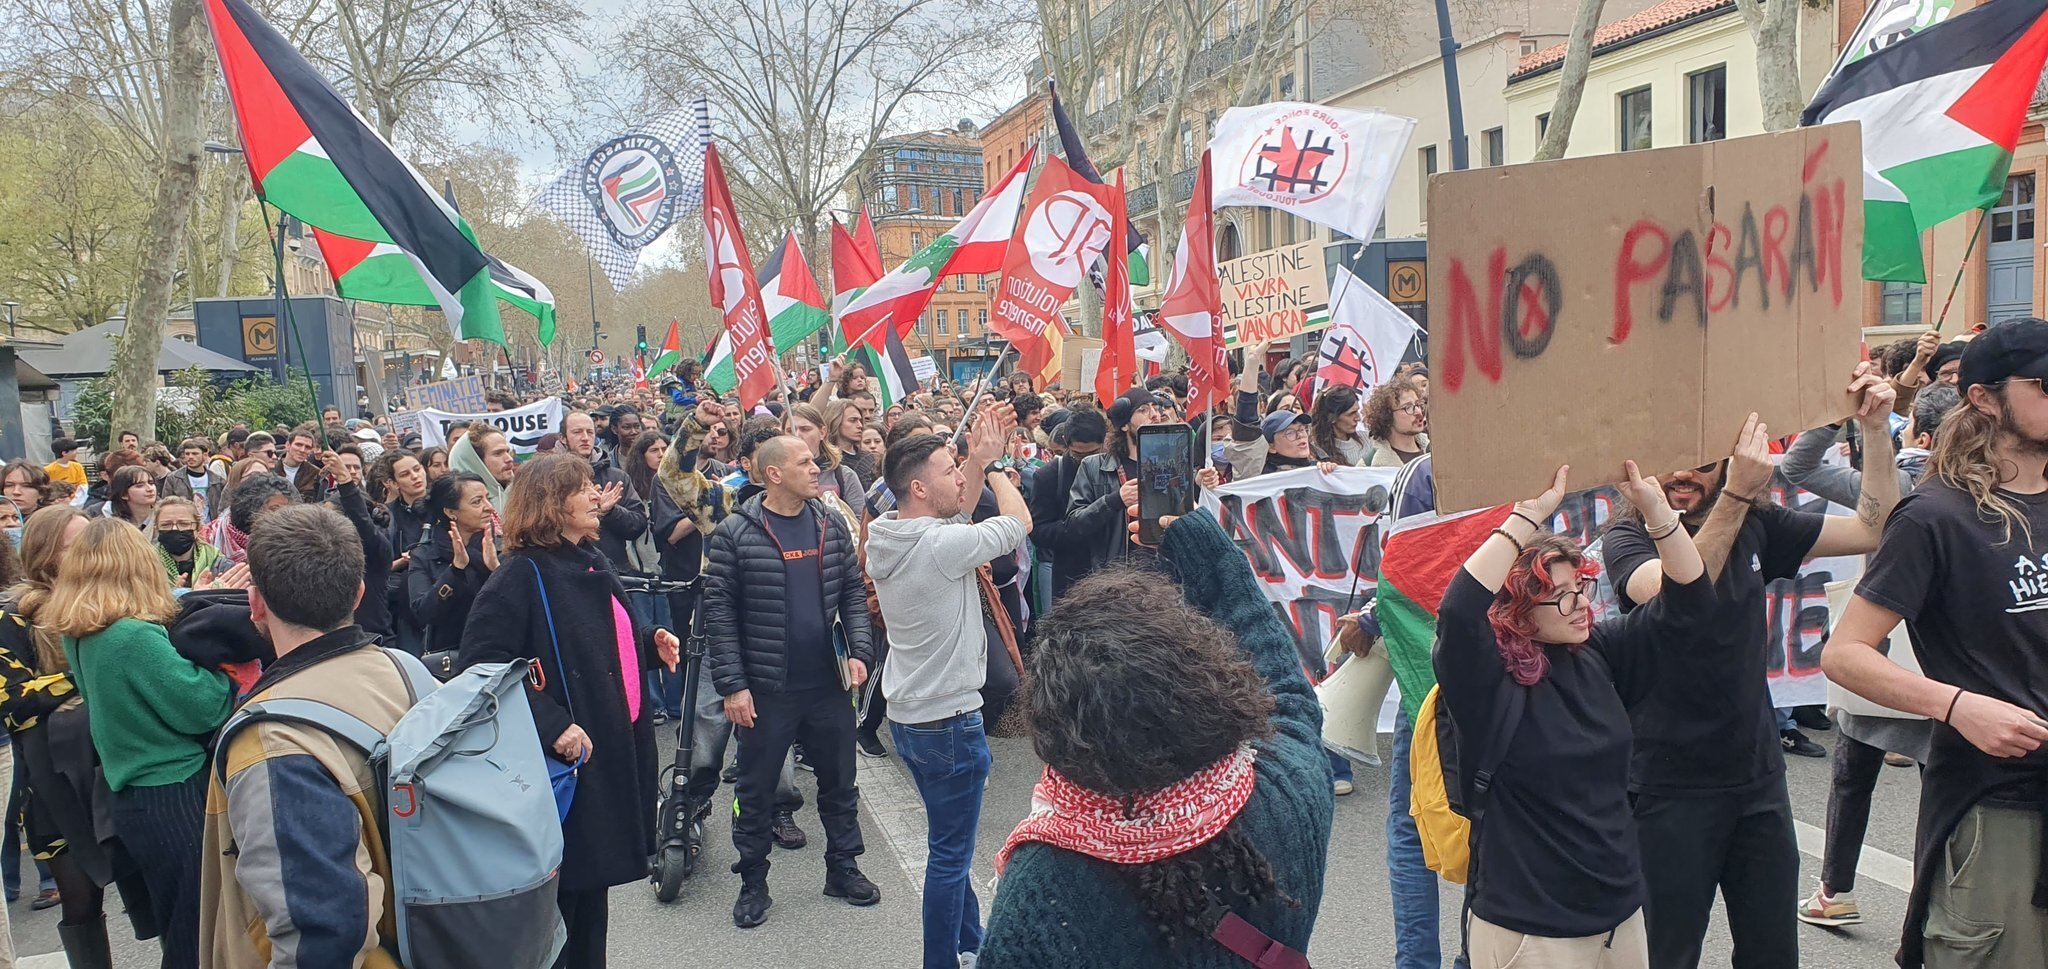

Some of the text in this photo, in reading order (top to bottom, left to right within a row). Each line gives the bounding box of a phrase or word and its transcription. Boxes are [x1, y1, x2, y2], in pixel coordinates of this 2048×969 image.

[1398, 273, 1416, 291] M
[1443, 246, 1562, 394] NO
[254, 328, 275, 345] M
